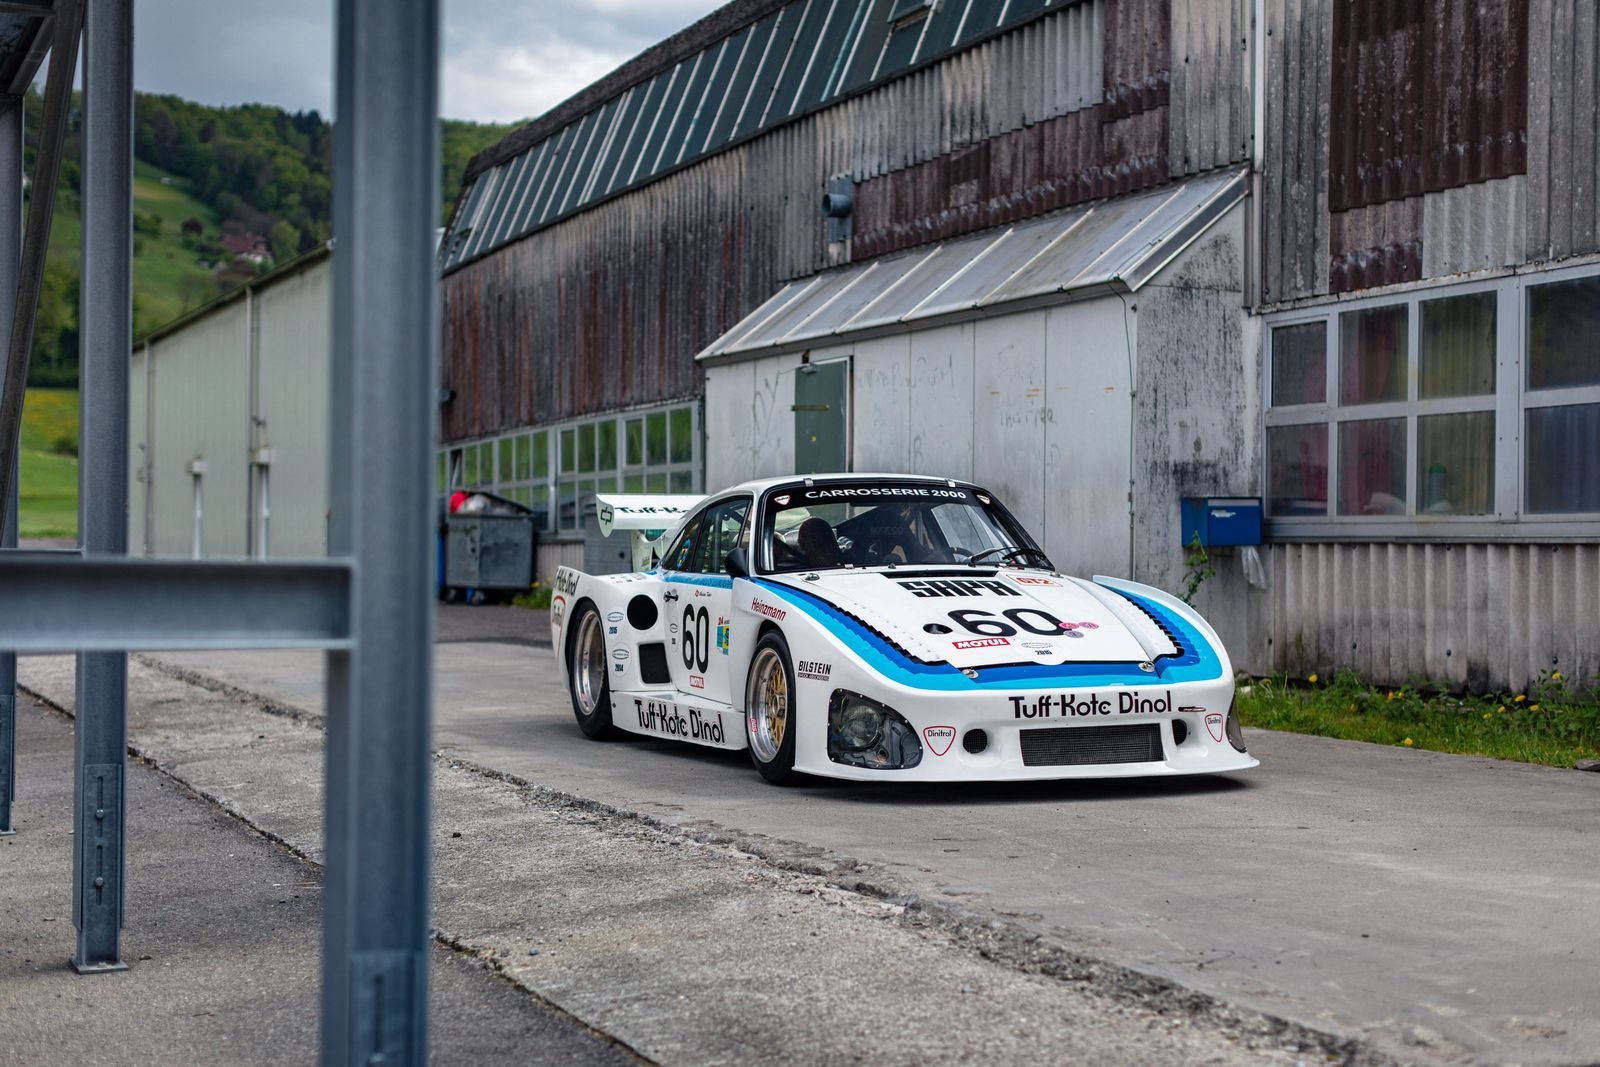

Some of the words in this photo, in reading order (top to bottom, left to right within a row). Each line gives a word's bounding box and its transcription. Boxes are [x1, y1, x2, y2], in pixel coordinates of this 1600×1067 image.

[805, 488, 929, 499] CARROSSERIE
[931, 489, 967, 498] 2000
[896, 580, 1023, 598] SAPA
[751, 597, 787, 621] Heinzmann
[947, 608, 1073, 637] 60
[682, 603, 709, 674] 60
[956, 638, 1008, 648] MOTUL
[798, 660, 832, 675] BILSTEIN
[1008, 693, 1112, 719] Tuff-Kote
[1118, 690, 1172, 714] Dinol
[634, 699, 688, 737] Tuff-Kote
[689, 709, 725, 743] Dinol
[927, 729, 952, 737] Dinitrol
